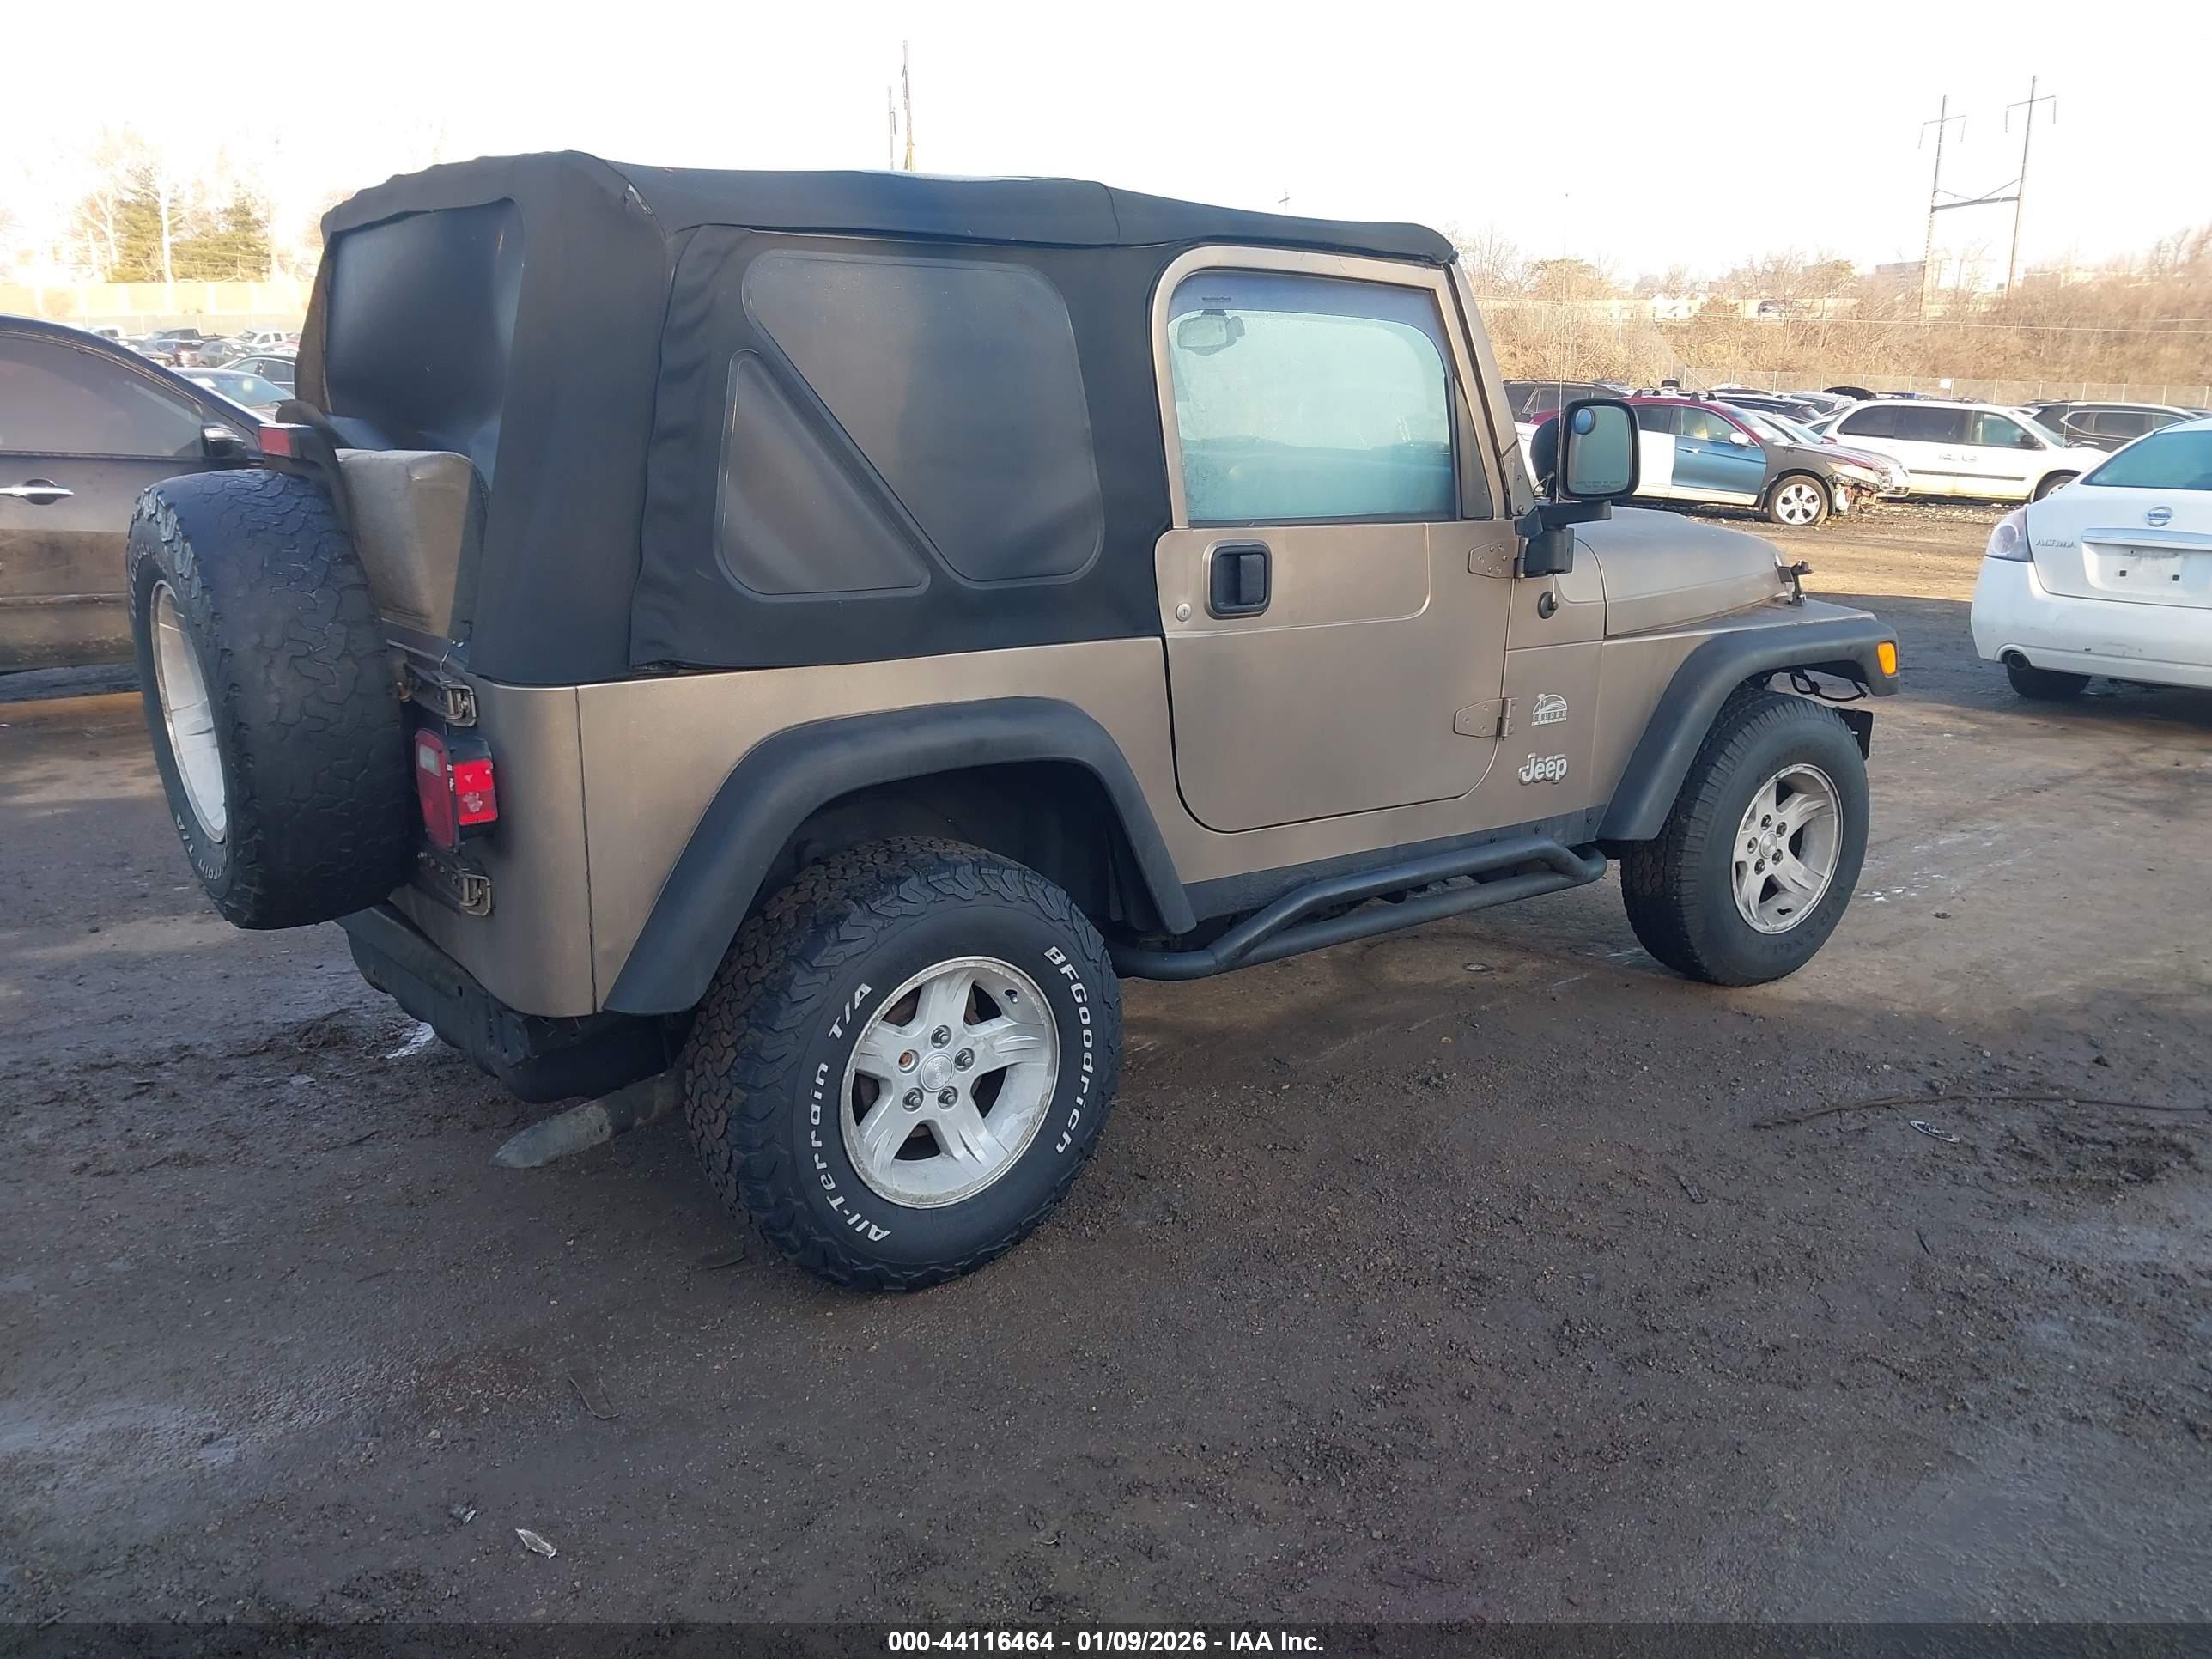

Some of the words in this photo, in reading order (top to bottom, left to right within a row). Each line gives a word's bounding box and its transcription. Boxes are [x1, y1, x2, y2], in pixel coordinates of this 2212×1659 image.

[1519, 753, 1568, 784] Jeep
[828, 982, 872, 1040] T/A
[1043, 945, 1095, 1155] BFGoodrich
[810, 1061, 892, 1243] All-Terrain
